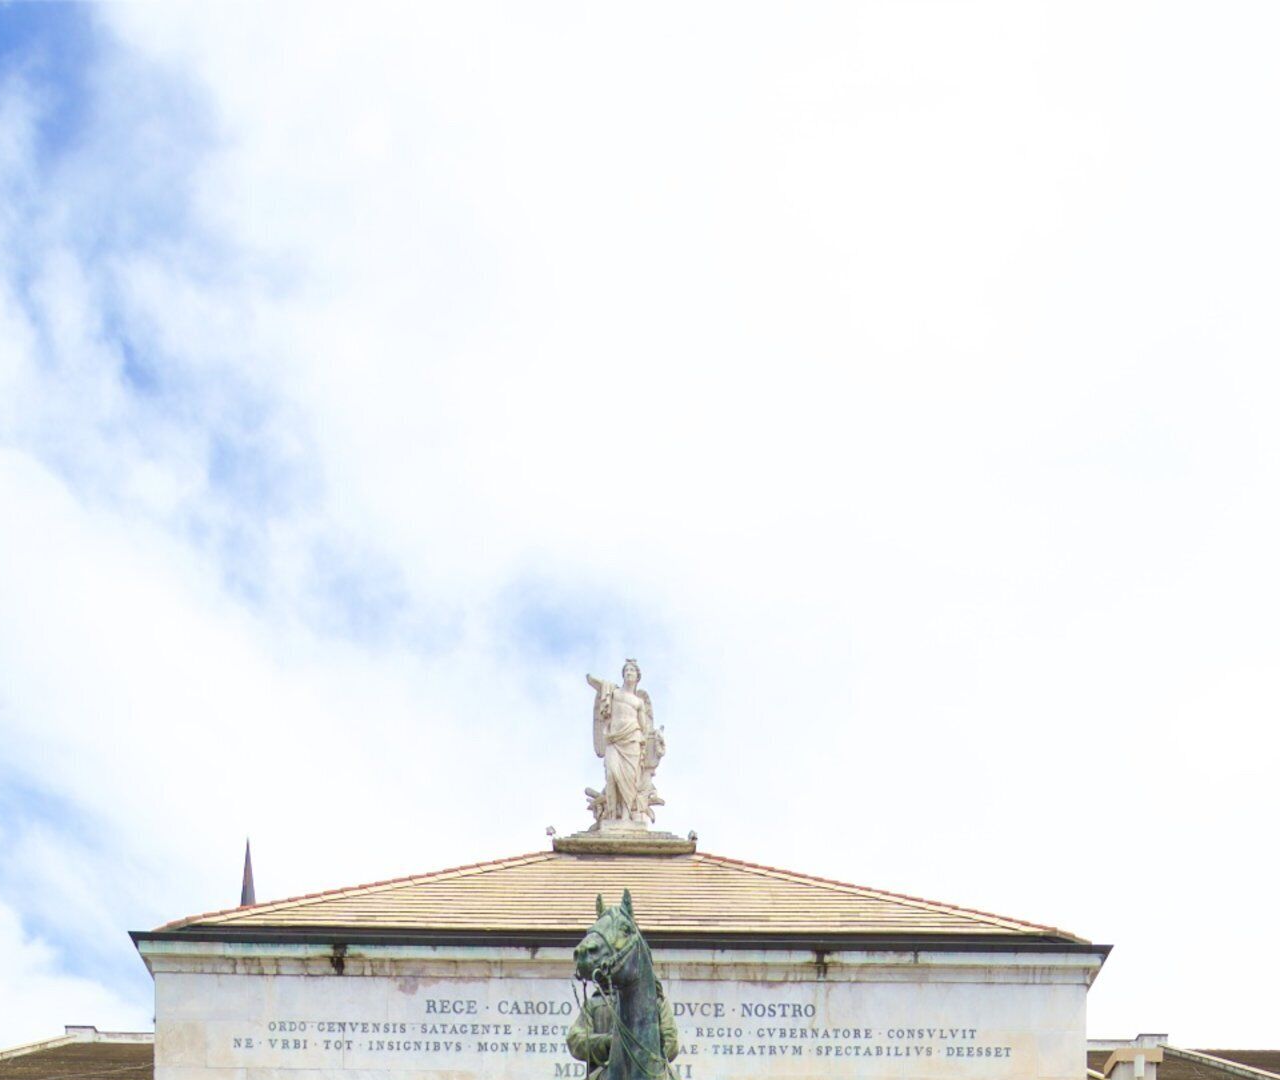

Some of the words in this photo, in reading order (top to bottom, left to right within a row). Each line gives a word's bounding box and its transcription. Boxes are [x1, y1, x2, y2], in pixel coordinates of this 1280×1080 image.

[425, 999, 477, 1015] REGE
[497, 1000, 573, 1016] CAROLO
[673, 1002, 726, 1018] DVCE
[740, 1002, 817, 1018] NOSTRO
[268, 1021, 307, 1033] ORDO
[317, 1021, 408, 1034] GENVENSIS
[420, 1022, 512, 1036] SATAGENTE
[695, 1027, 744, 1039] REGIO
[756, 1027, 873, 1040] GVBERNATORE
[886, 1028, 977, 1040] CONSVLVIT
[233, 1037, 254, 1049] NE
[268, 1038, 308, 1050] VRBI
[323, 1039, 354, 1051] TOT
[368, 1039, 463, 1052] INSIGNIBVS
[712, 1044, 803, 1056] THEATRVM
[816, 1045, 933, 1057] SPECTABILIVS
[946, 1046, 1012, 1058] DEESSET
